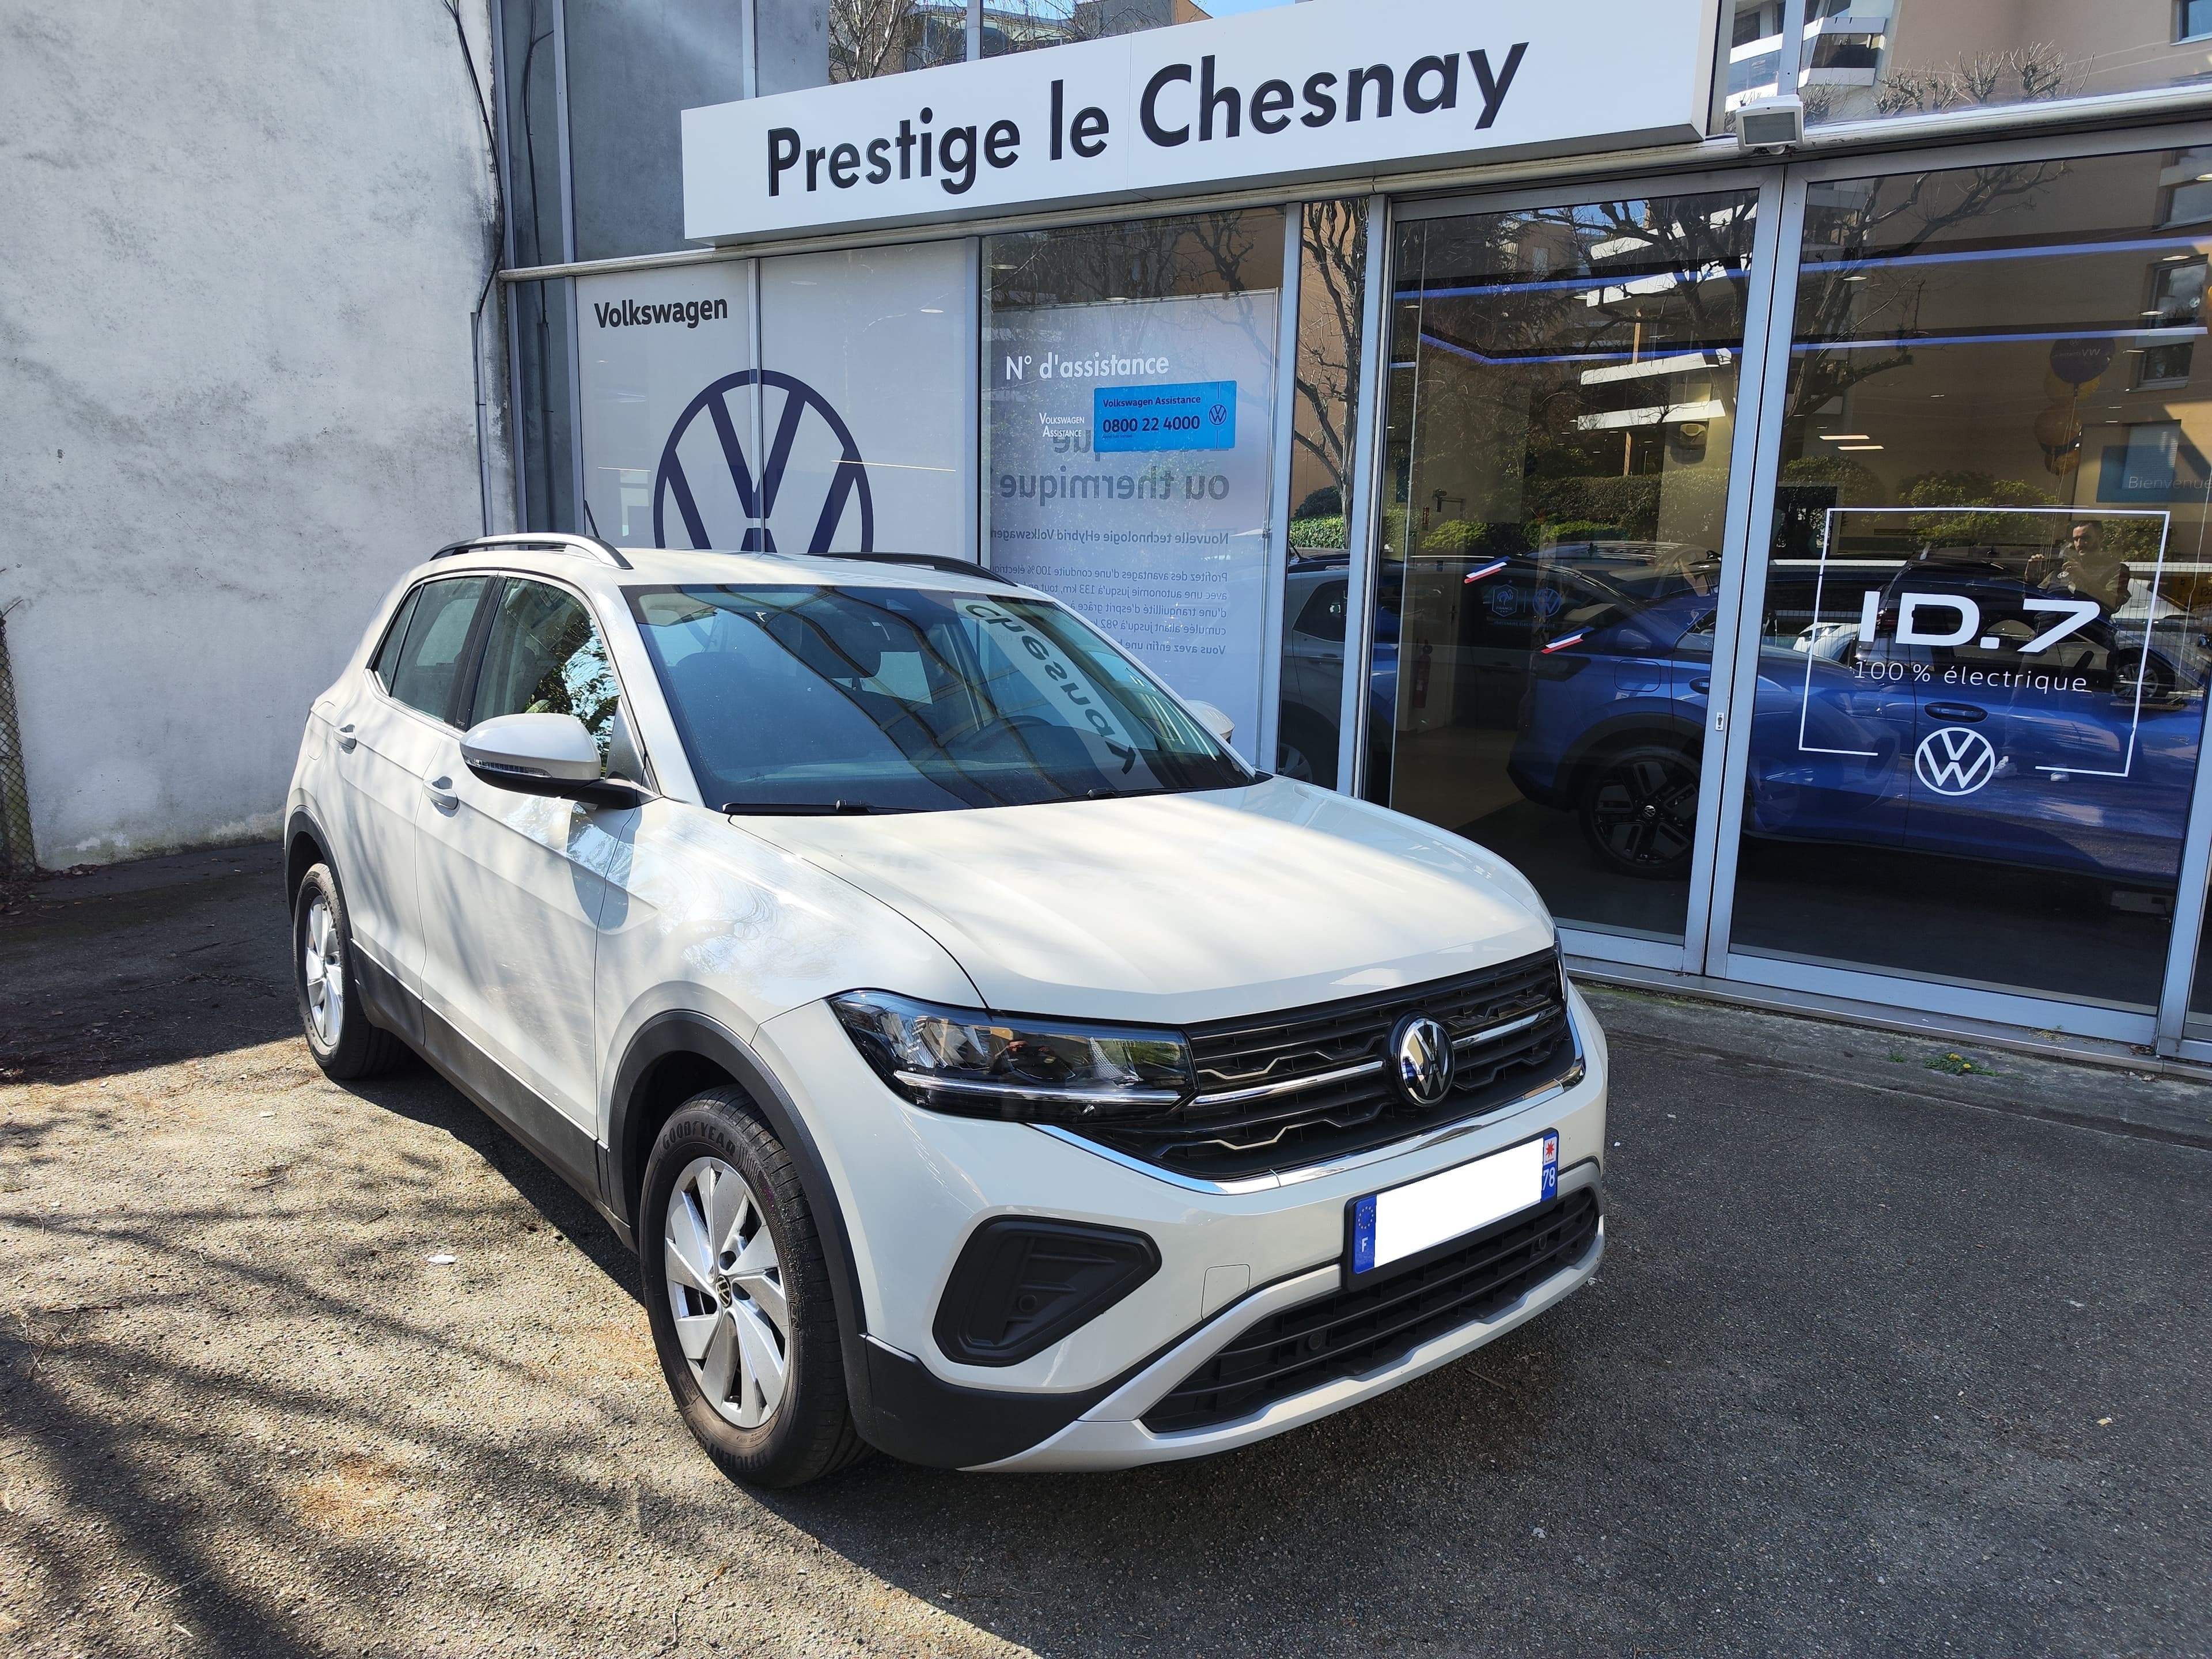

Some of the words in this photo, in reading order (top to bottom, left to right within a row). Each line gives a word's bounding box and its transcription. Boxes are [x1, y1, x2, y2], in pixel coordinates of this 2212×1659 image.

[768, 107, 1020, 196] Prestige
[1049, 79, 1109, 161] le
[1140, 42, 1530, 147] Chesnay
[594, 298, 728, 328] Volkswagen
[1005, 354, 1032, 380] N°
[1039, 351, 1169, 379] d'assistance
[1103, 399, 1153, 408] Volkswagen
[1155, 396, 1201, 405] Assistance
[1103, 418, 1138, 433] 0800
[1142, 417, 1159, 431] 22
[1163, 415, 1200, 430] 4000
[2128, 476, 2212, 489] Bienvenue
[1858, 590, 2100, 653] ID.7
[1944, 666, 2087, 694] électrique
[662, 1120, 736, 1157] GOODYEAR
[1542, 1166, 1555, 1191] 78
[1361, 1237, 1369, 1253] F
